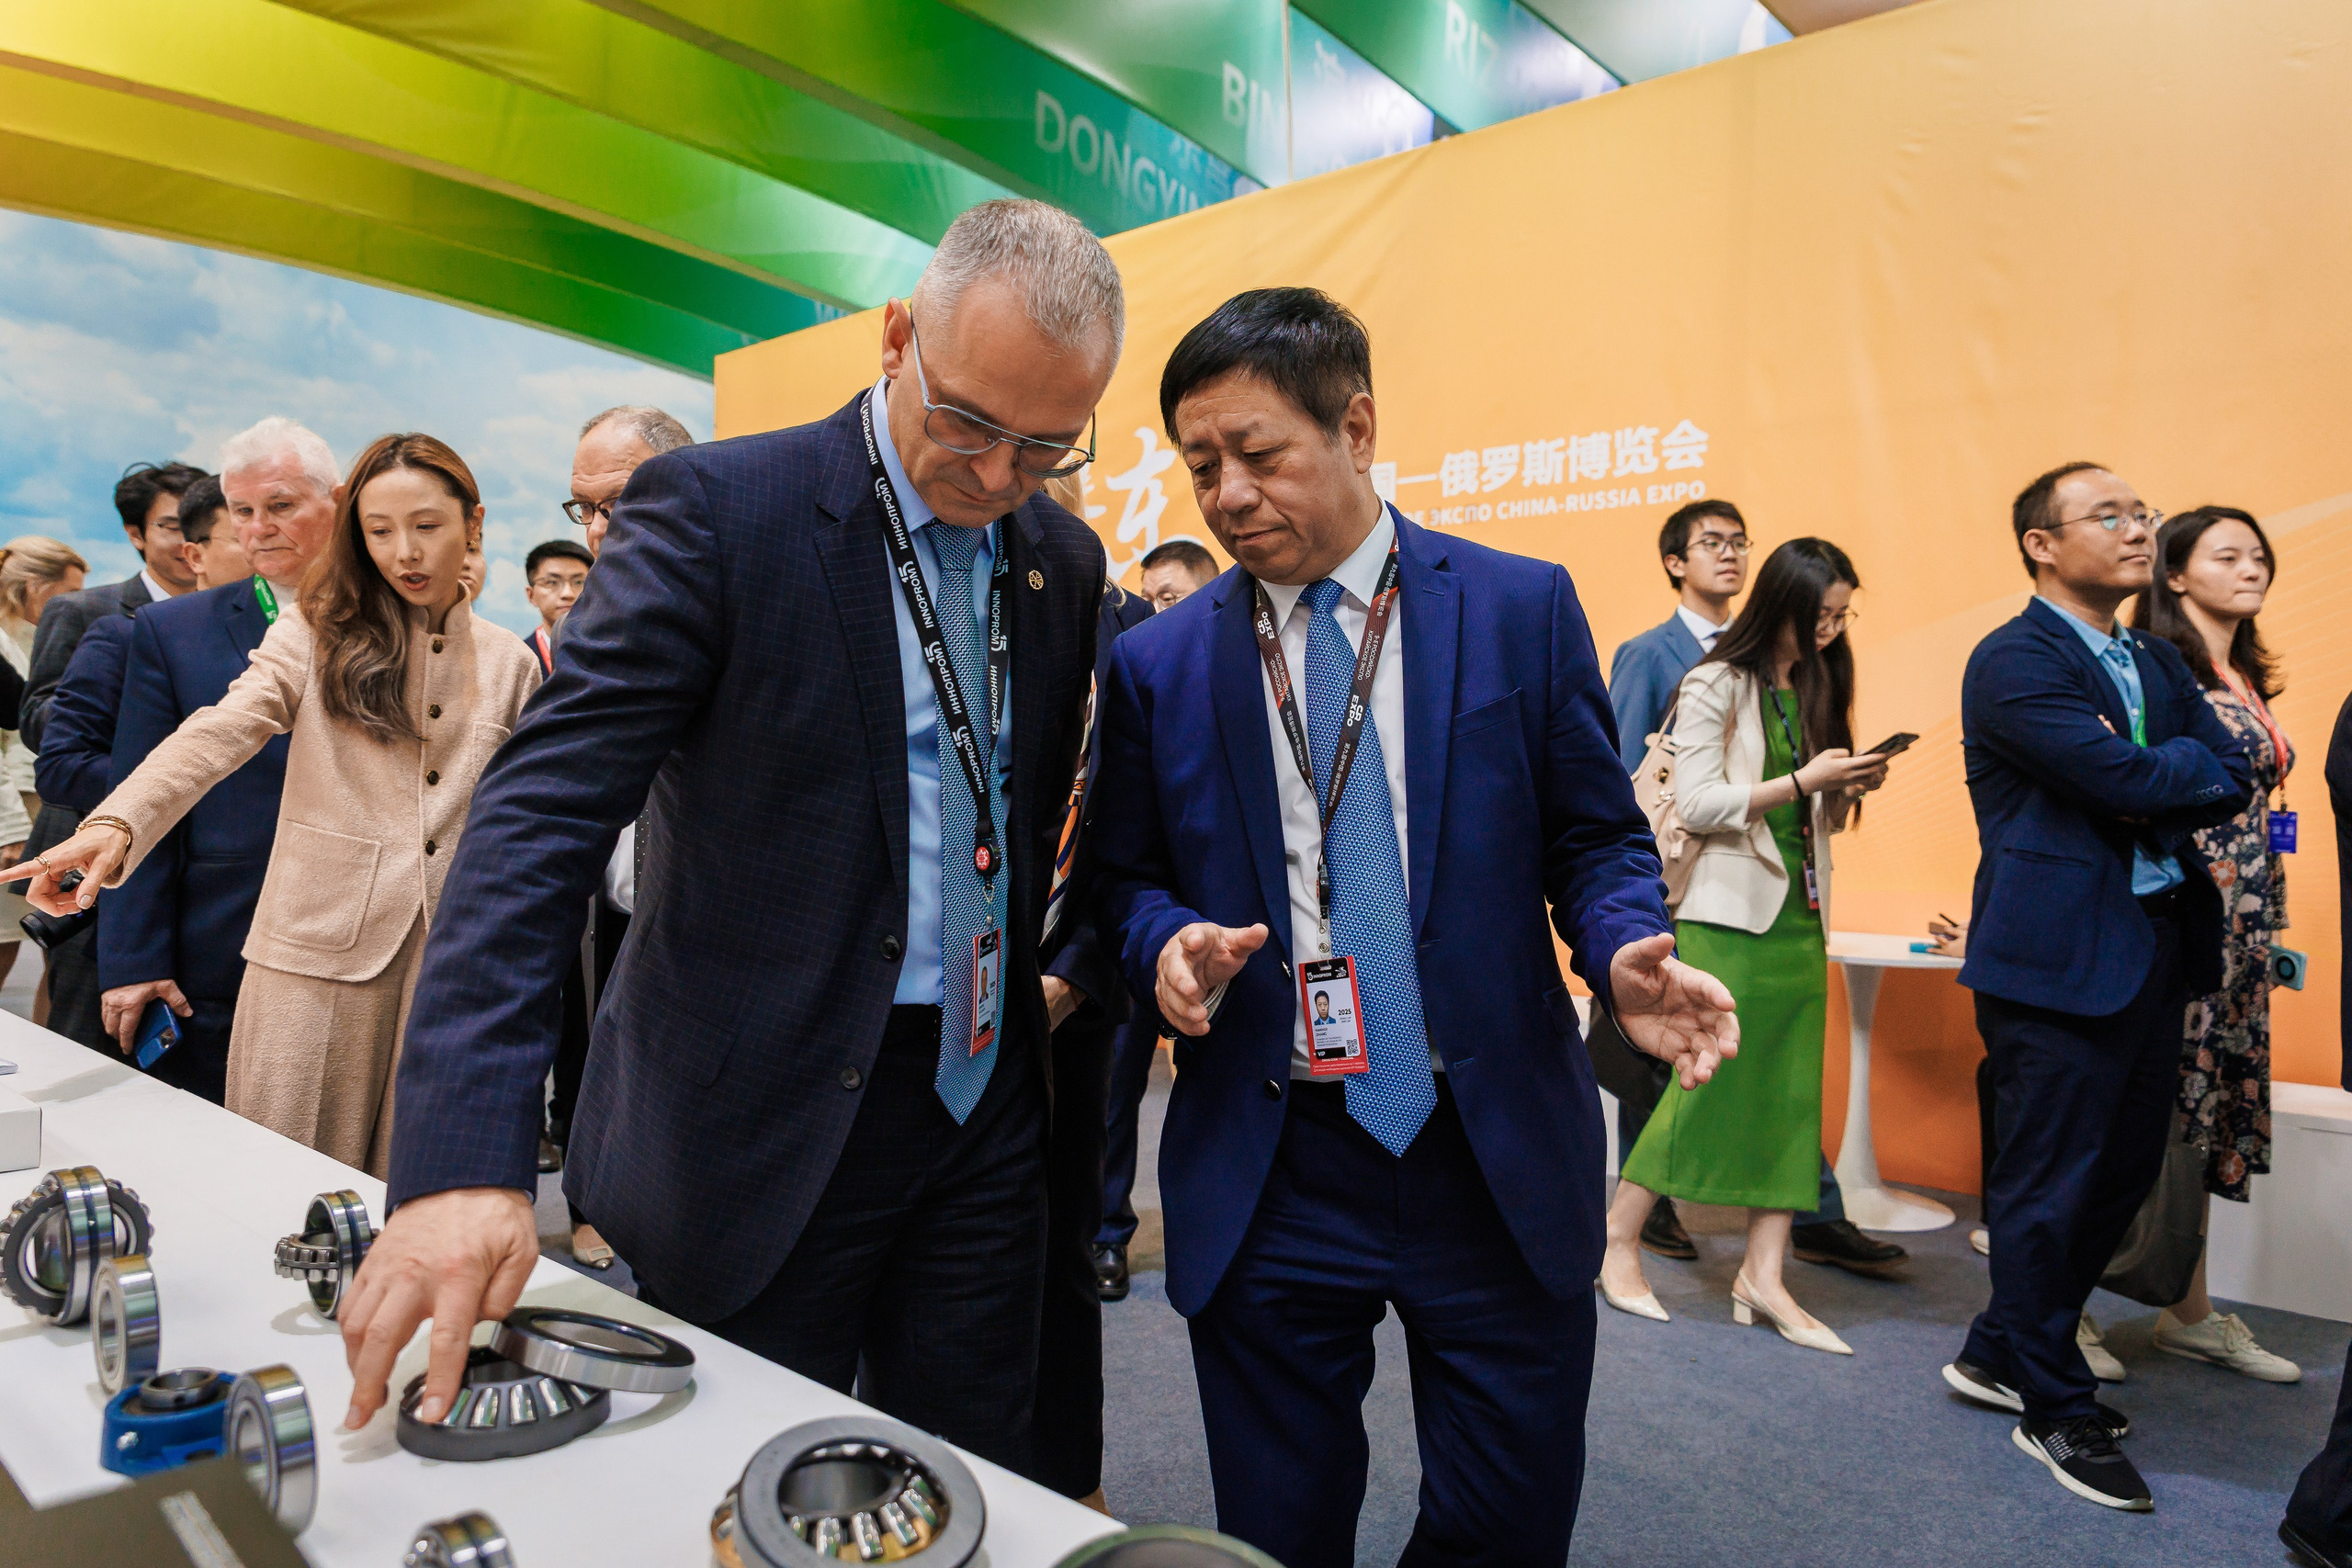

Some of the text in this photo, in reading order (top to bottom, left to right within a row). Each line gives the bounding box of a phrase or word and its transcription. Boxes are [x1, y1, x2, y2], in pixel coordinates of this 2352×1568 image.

[860, 408, 878, 465] INNOPROM
[878, 482, 908, 550] ИННОПРОМ
[1429, 502, 1492, 527] ЭКСПО
[1497, 487, 1641, 520] CHINA-RUSSIA
[1646, 479, 1706, 505] EXPO
[906, 567, 934, 629] INNOPROM
[990, 590, 1000, 644] INNOPROM
[1261, 610, 1275, 639] EXPO
[933, 647, 962, 715] ИННОПРОМ
[1345, 694, 1359, 728] EXPO
[960, 731, 985, 793] INNOPROM
